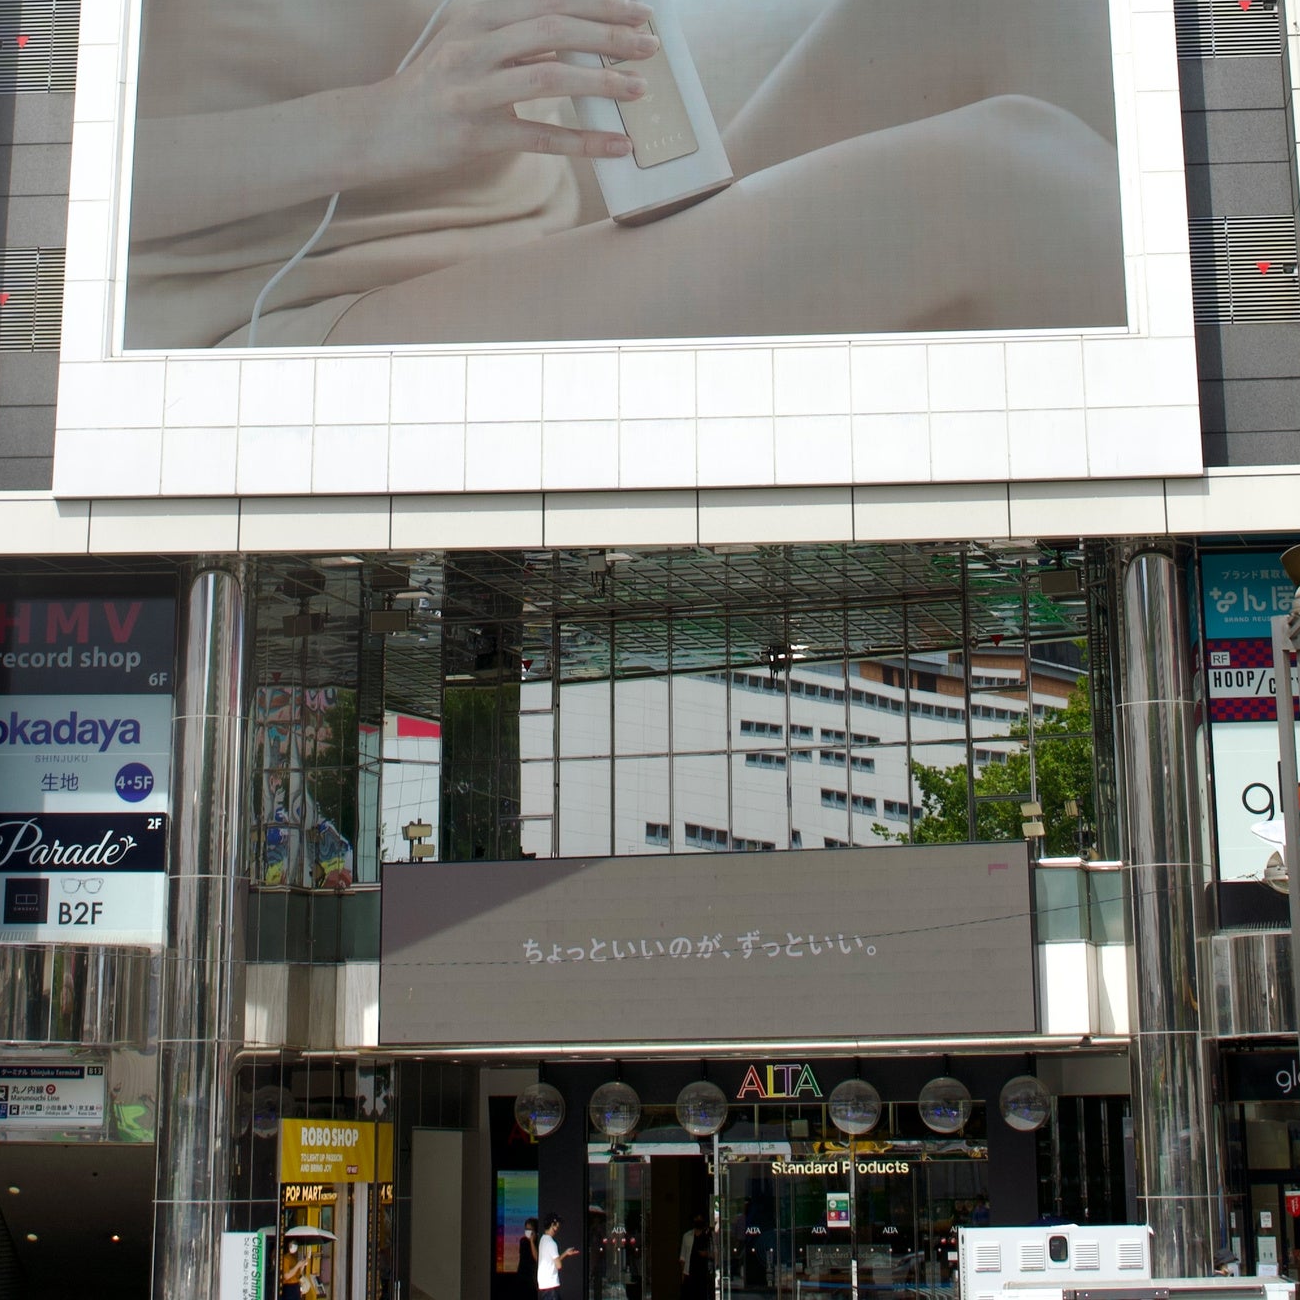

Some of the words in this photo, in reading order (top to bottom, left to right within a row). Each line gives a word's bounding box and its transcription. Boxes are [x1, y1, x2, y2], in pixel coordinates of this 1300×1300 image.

[1209, 585, 1297, 613] なんぼ
[80, 646, 141, 672] shop
[1212, 655, 1228, 665] RF
[149, 672, 168, 686] 6F
[1213, 670, 1300, 695] HOOP/C
[34, 755, 89, 763] SHINJUKU
[41, 773, 79, 792] 生地
[147, 818, 162, 830] 2F
[59, 901, 103, 925] B2F
[522, 929, 877, 965] ちょっといいのが、ずっといい。
[11, 1084, 44, 1095] 丸ノ内線
[737, 1063, 823, 1100] ALTA
[10, 1094, 46, 1102] Marunouchi
[46, 1094, 60, 1102] Line
[301, 1127, 330, 1146] ROBO
[332, 1128, 359, 1147] SHOP
[771, 1161, 838, 1175] Standard
[841, 1160, 910, 1175] Products
[285, 1185, 301, 1202] POP
[302, 1185, 323, 1201] MART
[251, 1236, 262, 1268] Clean
